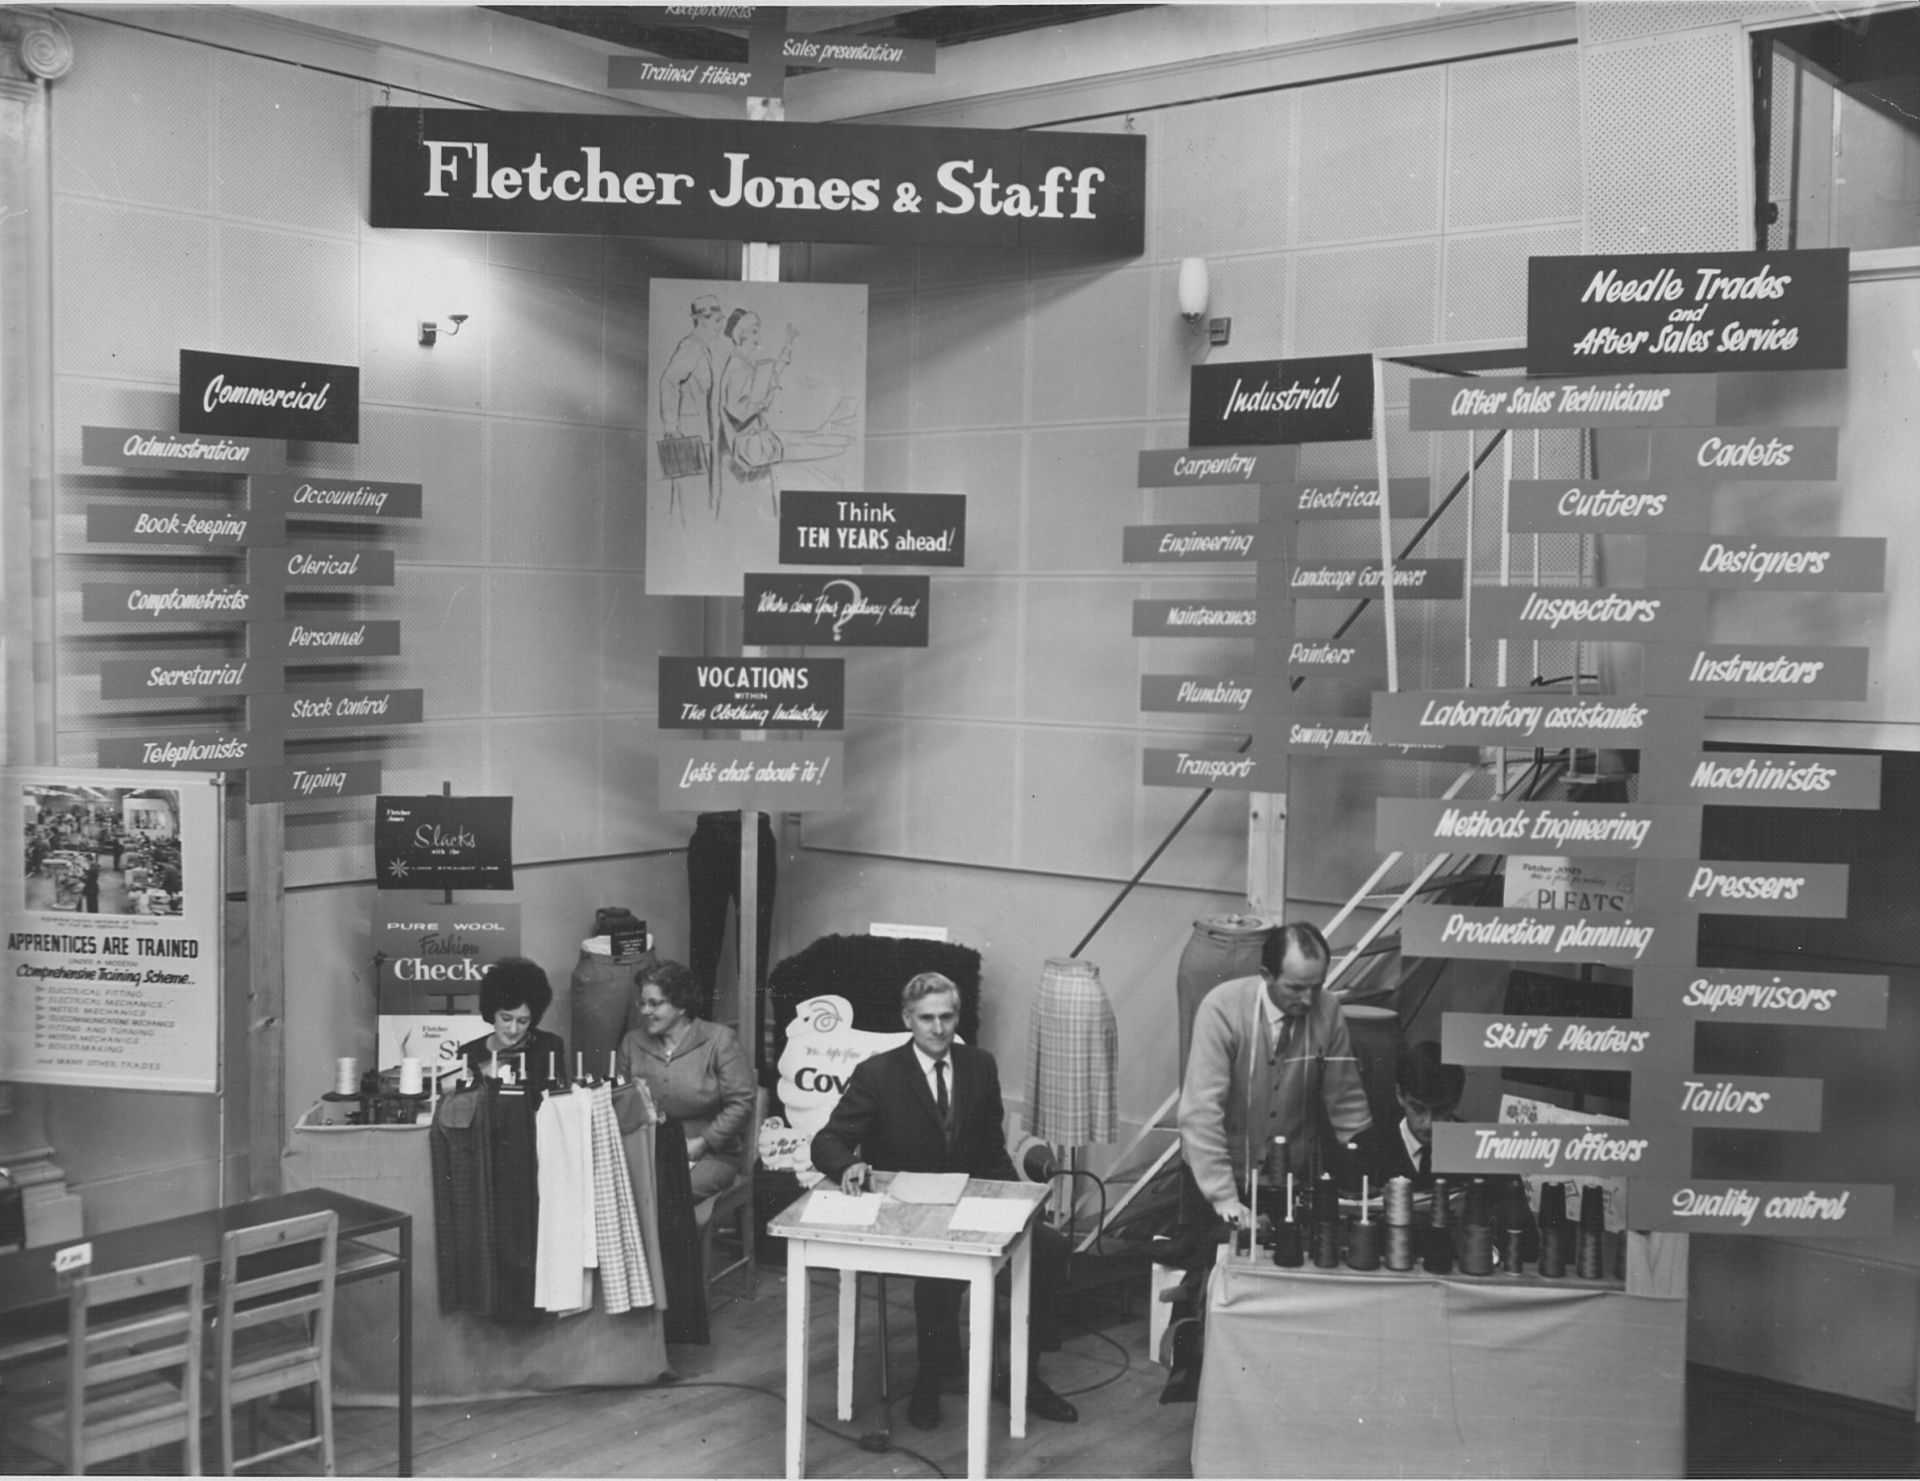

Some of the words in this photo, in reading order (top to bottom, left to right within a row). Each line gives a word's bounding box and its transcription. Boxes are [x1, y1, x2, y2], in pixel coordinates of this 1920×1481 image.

[782, 38, 821, 58] Sales
[818, 43, 904, 63] presentation
[640, 62, 698, 83] Trained
[699, 65, 752, 86] fitters
[422, 140, 695, 205] Fletcher
[709, 152, 880, 212] Jones
[892, 182, 922, 213] &
[936, 159, 1106, 219] Staff
[1581, 268, 1685, 303] Needle
[1694, 264, 1792, 301] Trades
[1668, 302, 1709, 322] and
[1573, 326, 1650, 355] After
[1648, 322, 1714, 354] Sales
[1716, 318, 1799, 353] Service
[203, 374, 331, 413] Commercial
[1223, 375, 1342, 420] Industrial
[1451, 388, 1508, 416] After
[1506, 385, 1556, 414] Sales
[1557, 382, 1671, 413] Technicians
[1173, 452, 1257, 479] Carpentry
[1697, 436, 1794, 467] Cadets
[293, 483, 388, 514] Accounting
[1296, 486, 1382, 508] Electrical
[1558, 487, 1668, 517] Cutters
[837, 501, 896, 523] Think
[133, 512, 247, 542] Book-keeping
[797, 526, 830, 548] TEN
[836, 527, 889, 550] YEARS
[895, 526, 957, 552] ahead!
[1158, 529, 1254, 556] Engineering
[287, 553, 360, 575] Clerical
[1699, 543, 1831, 583] Designers
[1290, 566, 1356, 591] Landscape
[127, 587, 249, 617] Comptometrists
[1166, 607, 1257, 626] Maintenance
[1519, 592, 1661, 629] Inspectors
[288, 625, 366, 647] Personnel
[1288, 642, 1355, 664] Painters
[1689, 651, 1824, 684] Instructors
[146, 663, 247, 687] Secretarial
[697, 666, 809, 689] VOCATIONS
[291, 697, 333, 718] Stock
[336, 694, 390, 716] Control
[1176, 680, 1253, 710] Plumbing
[680, 703, 707, 721] The
[710, 703, 770, 727] Clothing
[772, 703, 829, 728] Industry
[1419, 700, 1543, 736] Laboratory
[1544, 701, 1649, 729] assistants
[1289, 722, 1333, 750] Sewing
[142, 737, 248, 768] Telephonists
[292, 766, 347, 795] Typing
[717, 759, 755, 782] chat
[754, 760, 800, 782] about
[800, 757, 830, 785] it!
[1176, 753, 1256, 782] Transport
[1690, 758, 1837, 792] Machinists
[413, 823, 476, 849] Slacks
[1433, 808, 1530, 839] Methods
[1530, 810, 1652, 849] Engineering
[1687, 867, 1805, 900] Pressers
[387, 922, 439, 931] PURE
[453, 922, 505, 931] WOOL
[1440, 913, 1556, 945] Production
[1554, 918, 1655, 959] planning
[6, 932, 97, 955] APPRENTICES
[102, 936, 129, 956] ARE
[135, 937, 199, 959] TRAINED
[418, 933, 480, 956] Fashion
[15, 964, 97, 983] Comprehensive
[97, 967, 142, 987] Training
[1682, 977, 1838, 1012] Supervisors
[1483, 1022, 1553, 1050] Skirt
[1557, 1024, 1650, 1053] Pleaters
[1681, 1081, 1771, 1114] Tailors
[1474, 1129, 1561, 1169] Training
[1564, 1125, 1649, 1162] officers
[1672, 1188, 1761, 1226] Quality
[1764, 1190, 1850, 1221] control
